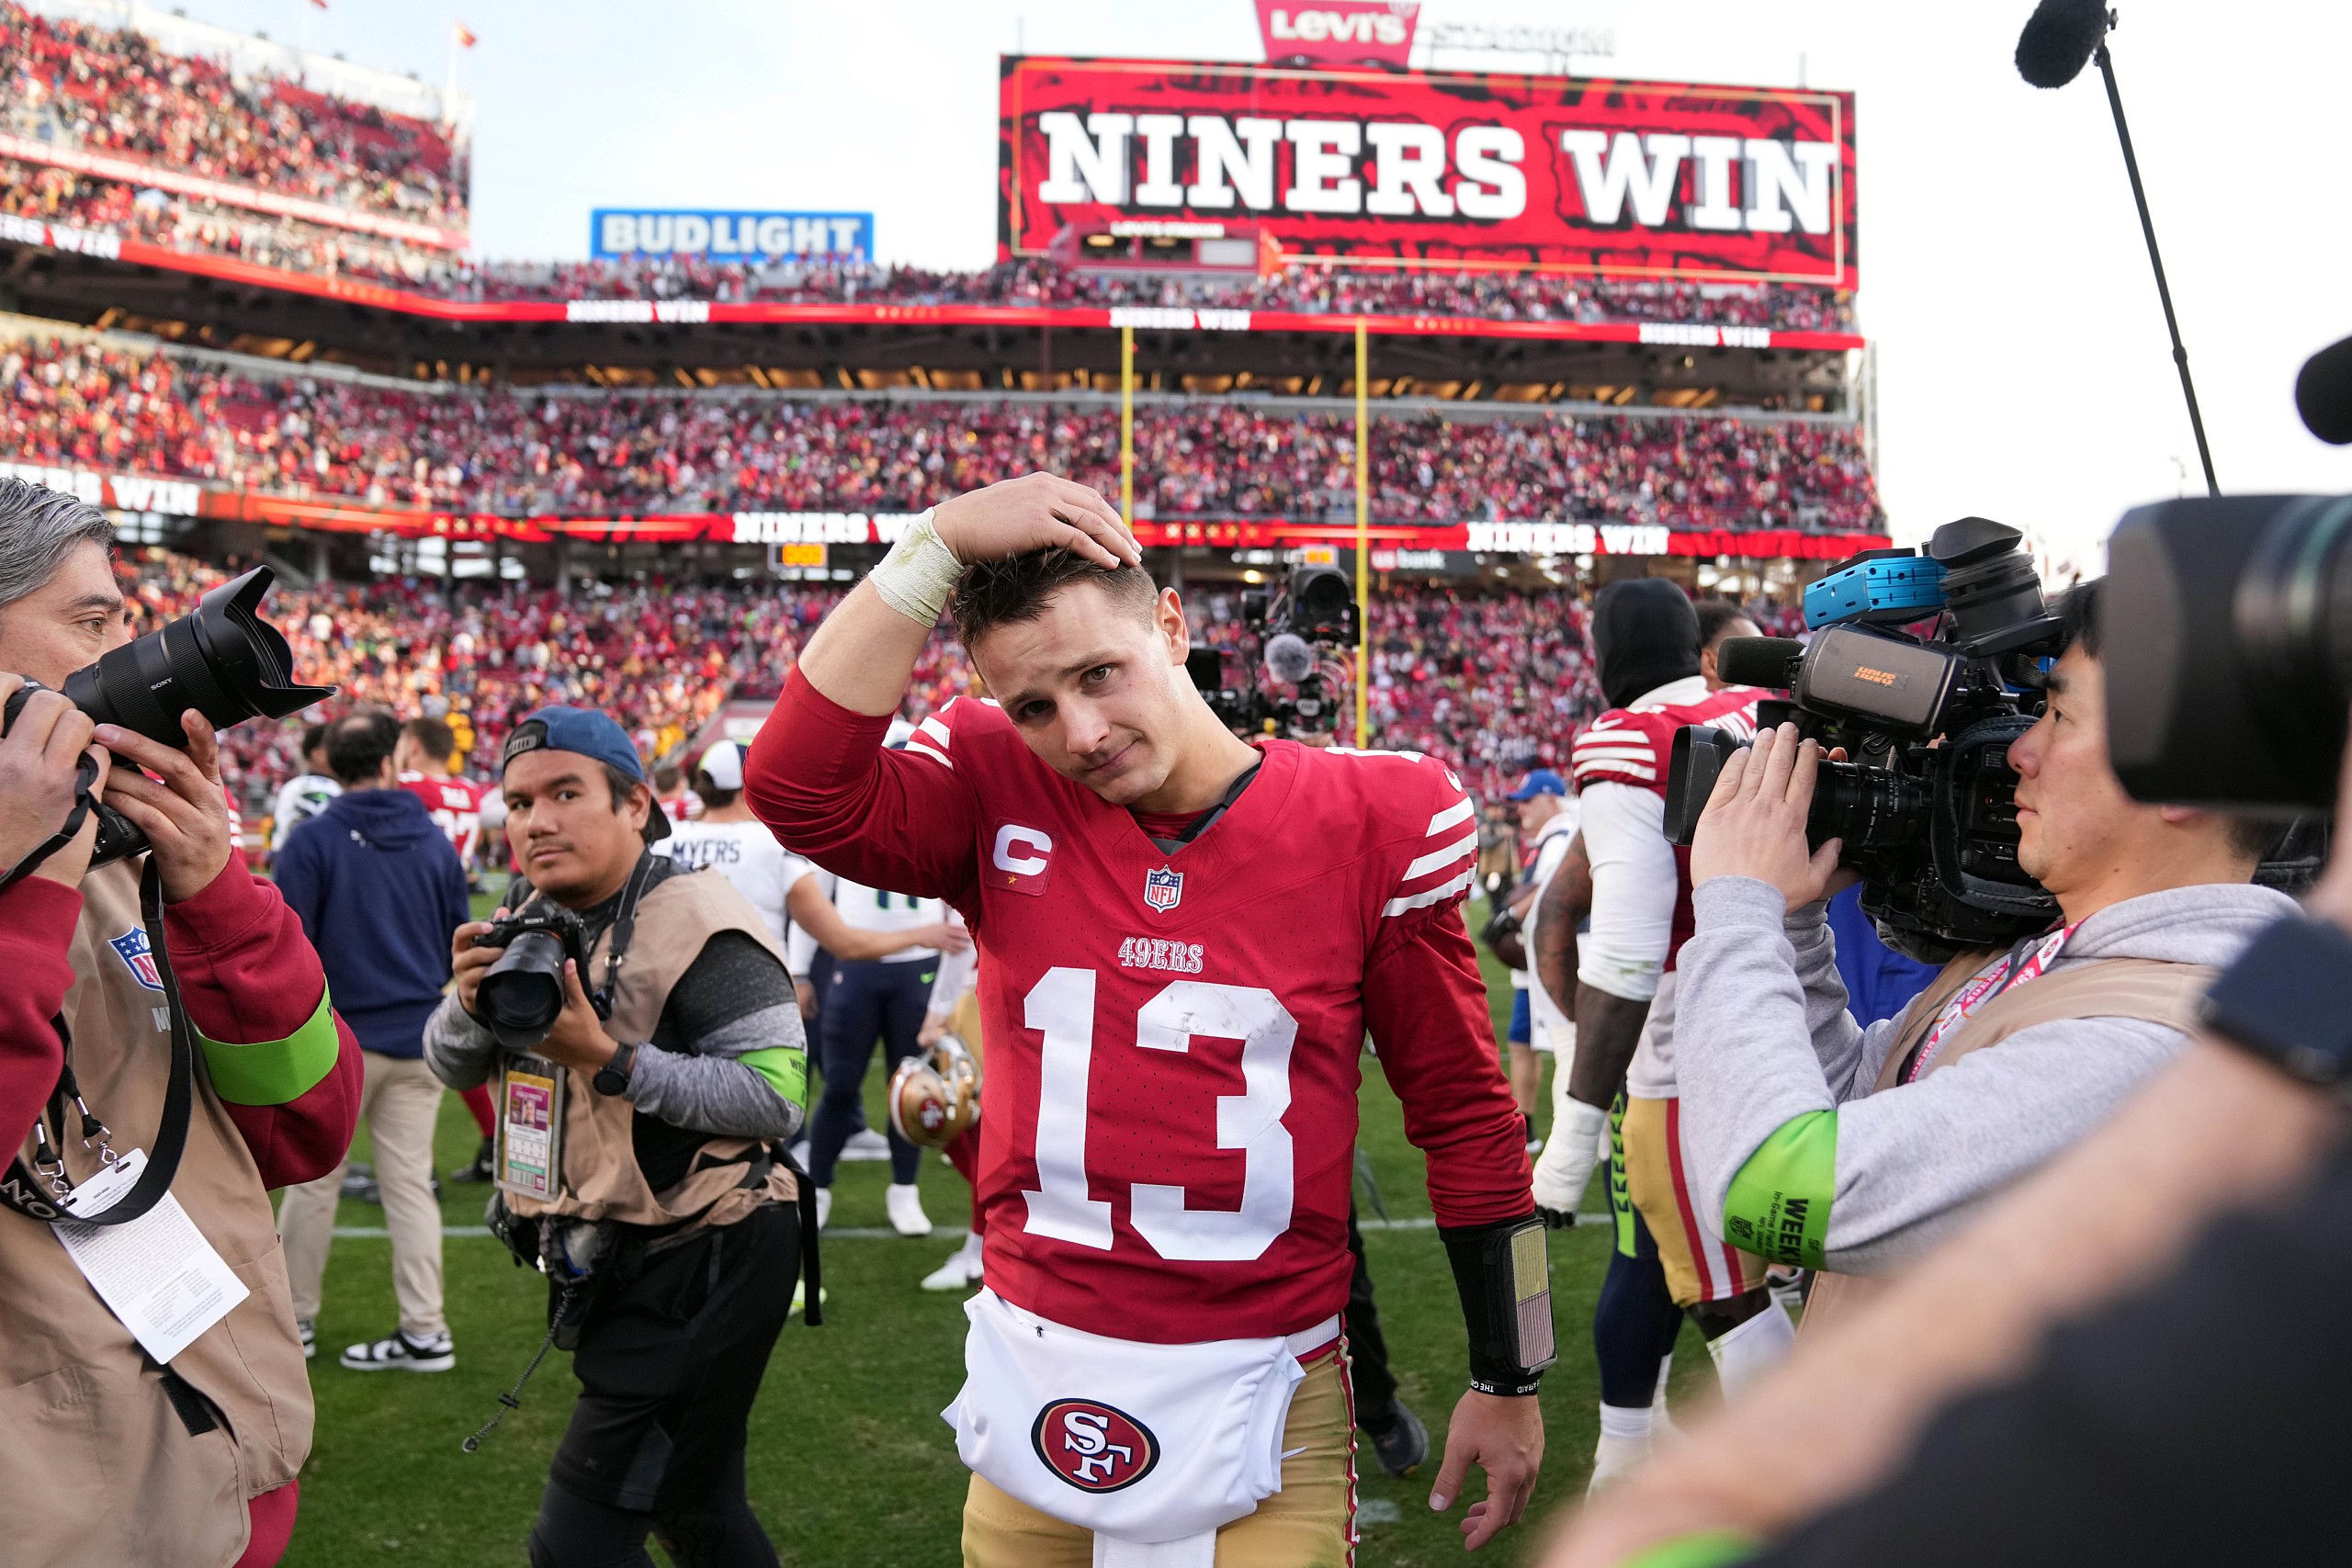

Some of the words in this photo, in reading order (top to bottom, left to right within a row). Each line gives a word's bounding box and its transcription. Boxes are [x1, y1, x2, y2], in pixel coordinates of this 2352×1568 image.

[1038, 111, 1527, 220] NINERS
[1561, 130, 1837, 233] WIN
[109, 475, 200, 516] WIN
[732, 512, 869, 544] NINERS
[1466, 521, 1597, 552] NINERS
[1600, 525, 1670, 555] WIN
[151, 677, 173, 691] SONY
[672, 840, 741, 863] MYERS
[993, 824, 1053, 876] C
[1150, 886, 1175, 904] NFL
[1118, 937, 1204, 975] 49ERS
[1023, 967, 1298, 1262] 13
[1480, 1382, 1494, 1393] THE
[1064, 1411, 1132, 1483] SF
